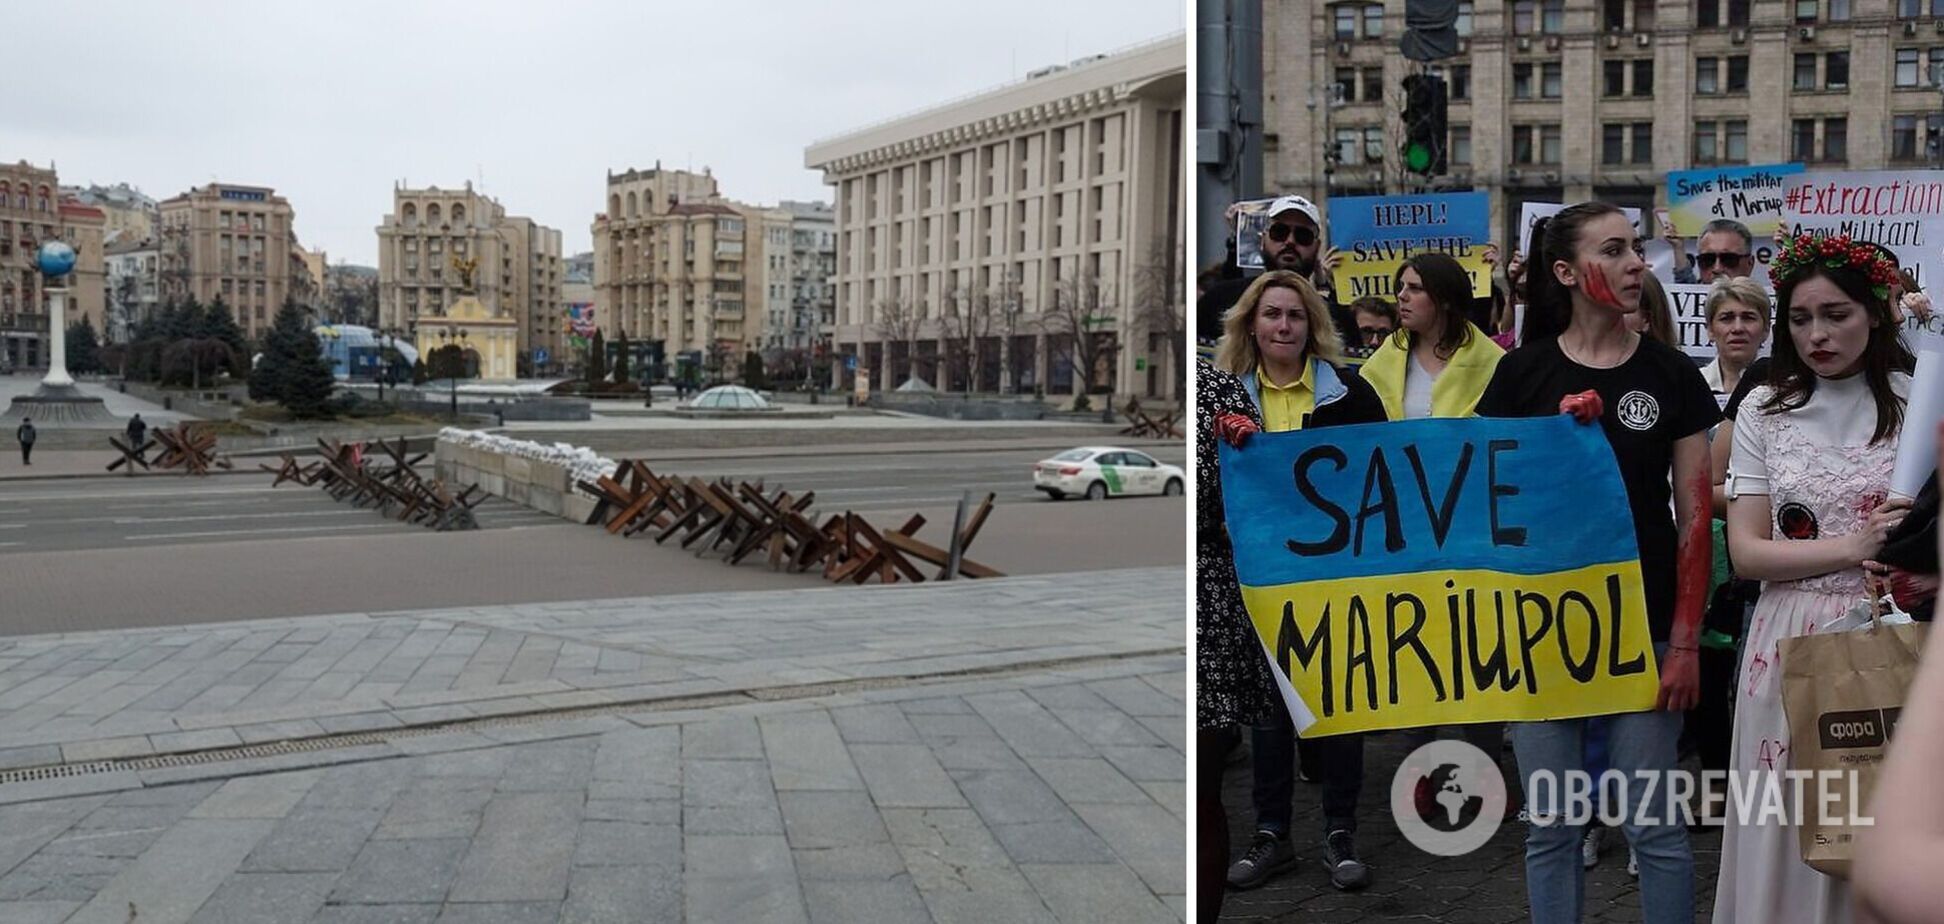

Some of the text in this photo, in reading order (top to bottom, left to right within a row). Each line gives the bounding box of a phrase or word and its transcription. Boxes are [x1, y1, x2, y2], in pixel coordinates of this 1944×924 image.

[1741, 172, 1783, 190] militar
[1712, 192, 1783, 218] of Mariup
[1786, 180, 1942, 216] #Extraction
[1374, 204, 1447, 227] HEPL!
[1353, 236, 1473, 263] SAVE THE
[1286, 439, 1528, 557] SAVE
